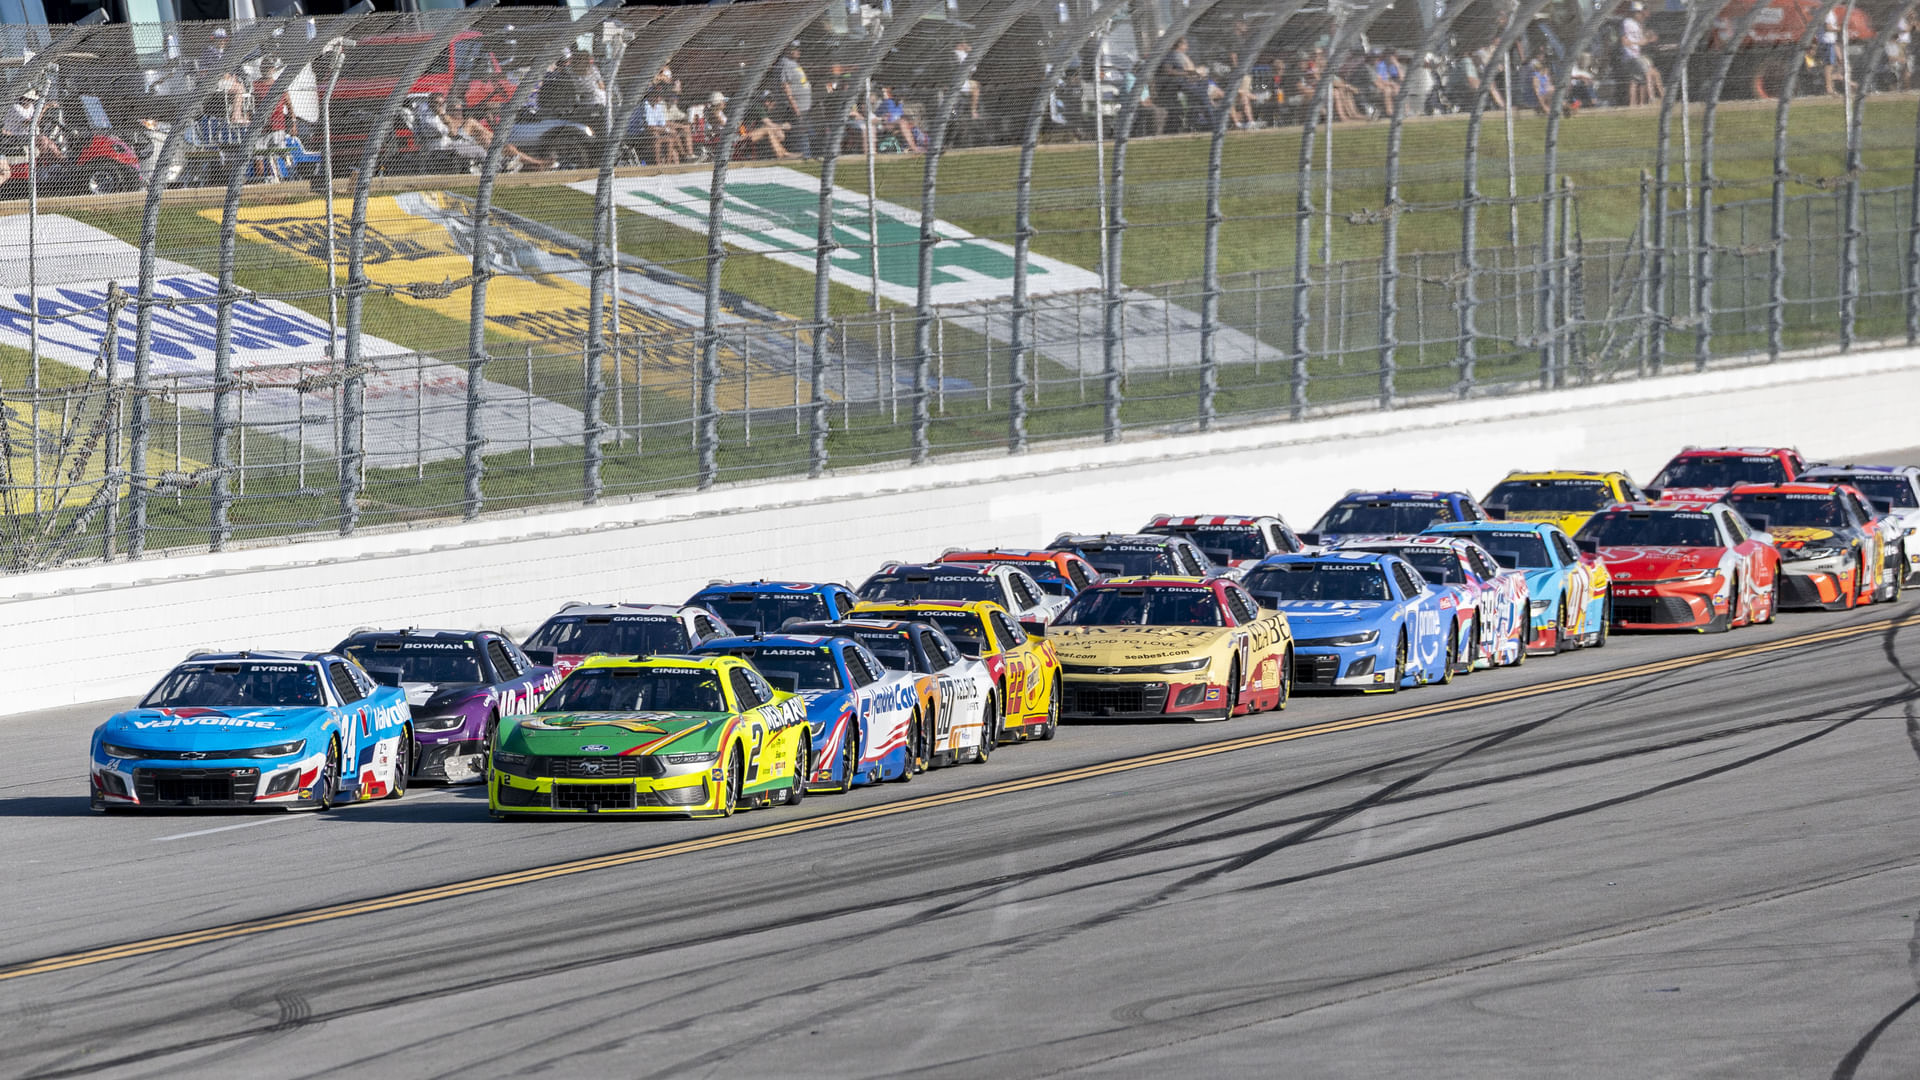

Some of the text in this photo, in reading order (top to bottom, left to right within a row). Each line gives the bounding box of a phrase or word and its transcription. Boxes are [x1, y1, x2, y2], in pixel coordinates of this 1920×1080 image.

[1125, 649, 1190, 660] seabest.com
[1007, 661, 1025, 715] 22
[134, 715, 277, 730] Valvoline
[745, 722, 764, 783] 2
